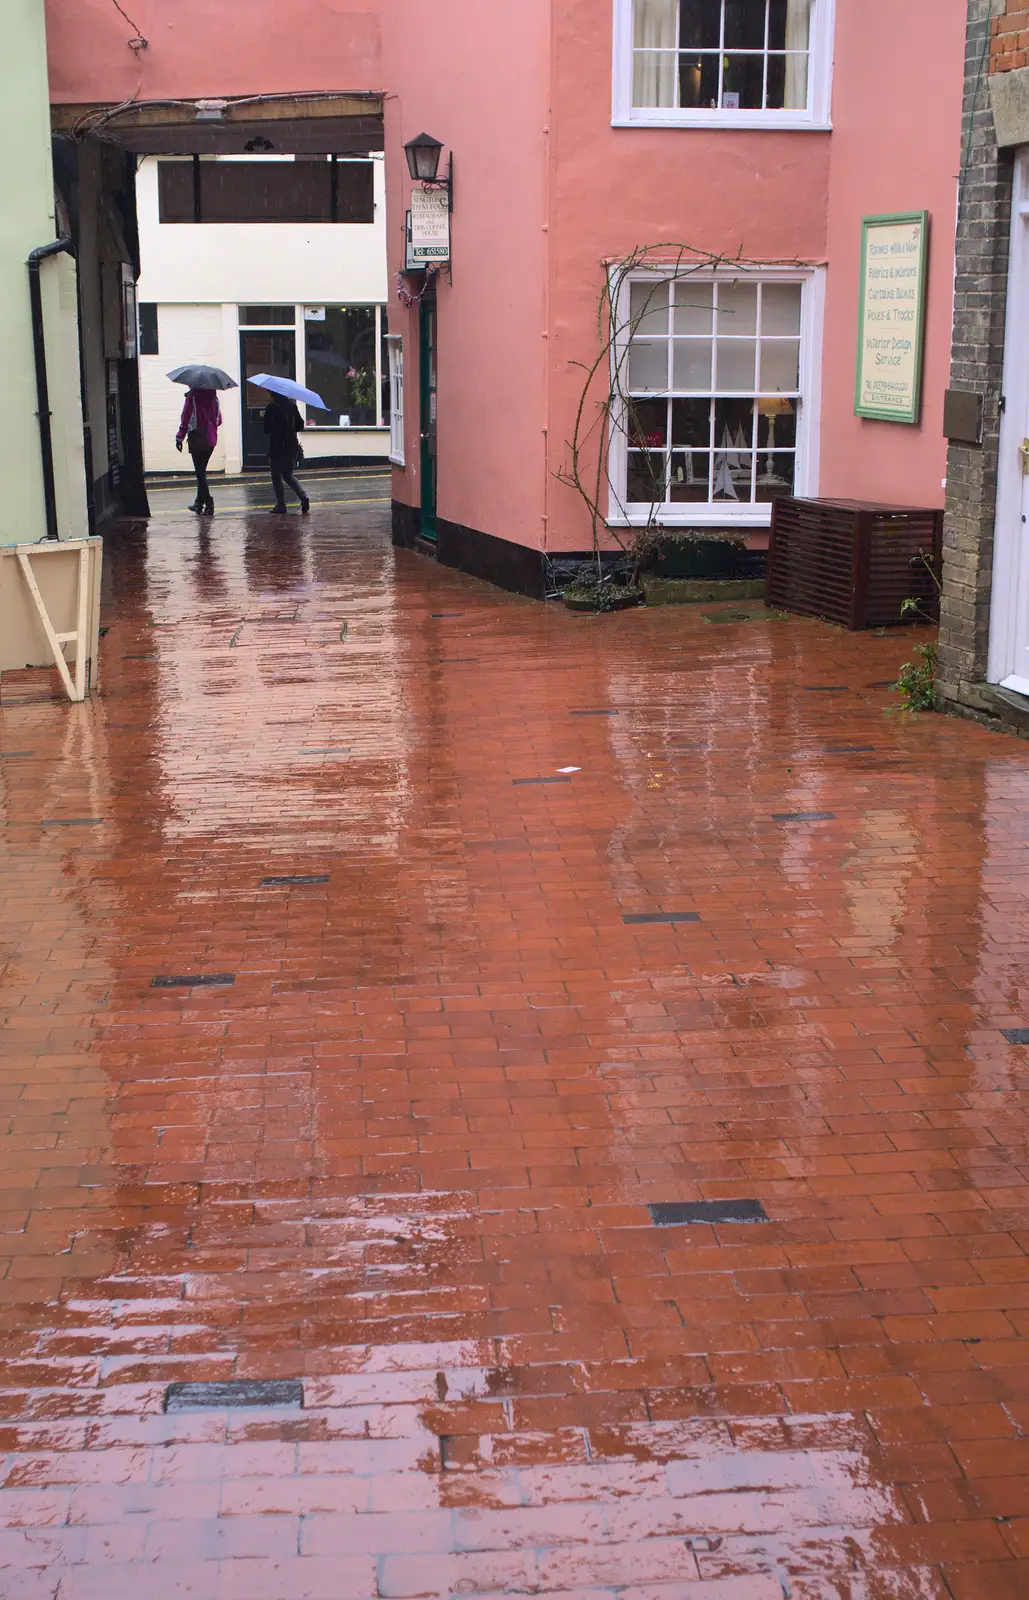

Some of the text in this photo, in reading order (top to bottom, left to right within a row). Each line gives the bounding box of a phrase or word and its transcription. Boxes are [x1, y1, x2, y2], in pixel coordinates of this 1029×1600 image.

[869, 267, 888, 278] Fabrics
[896, 288, 914, 299] Blinds
[868, 310, 884, 320] Poles
[894, 309, 914, 320] Tracks
[867, 338, 911, 354] Interior Design
[876, 353, 900, 365] Service
[872, 395, 903, 403] ENTRANCE
